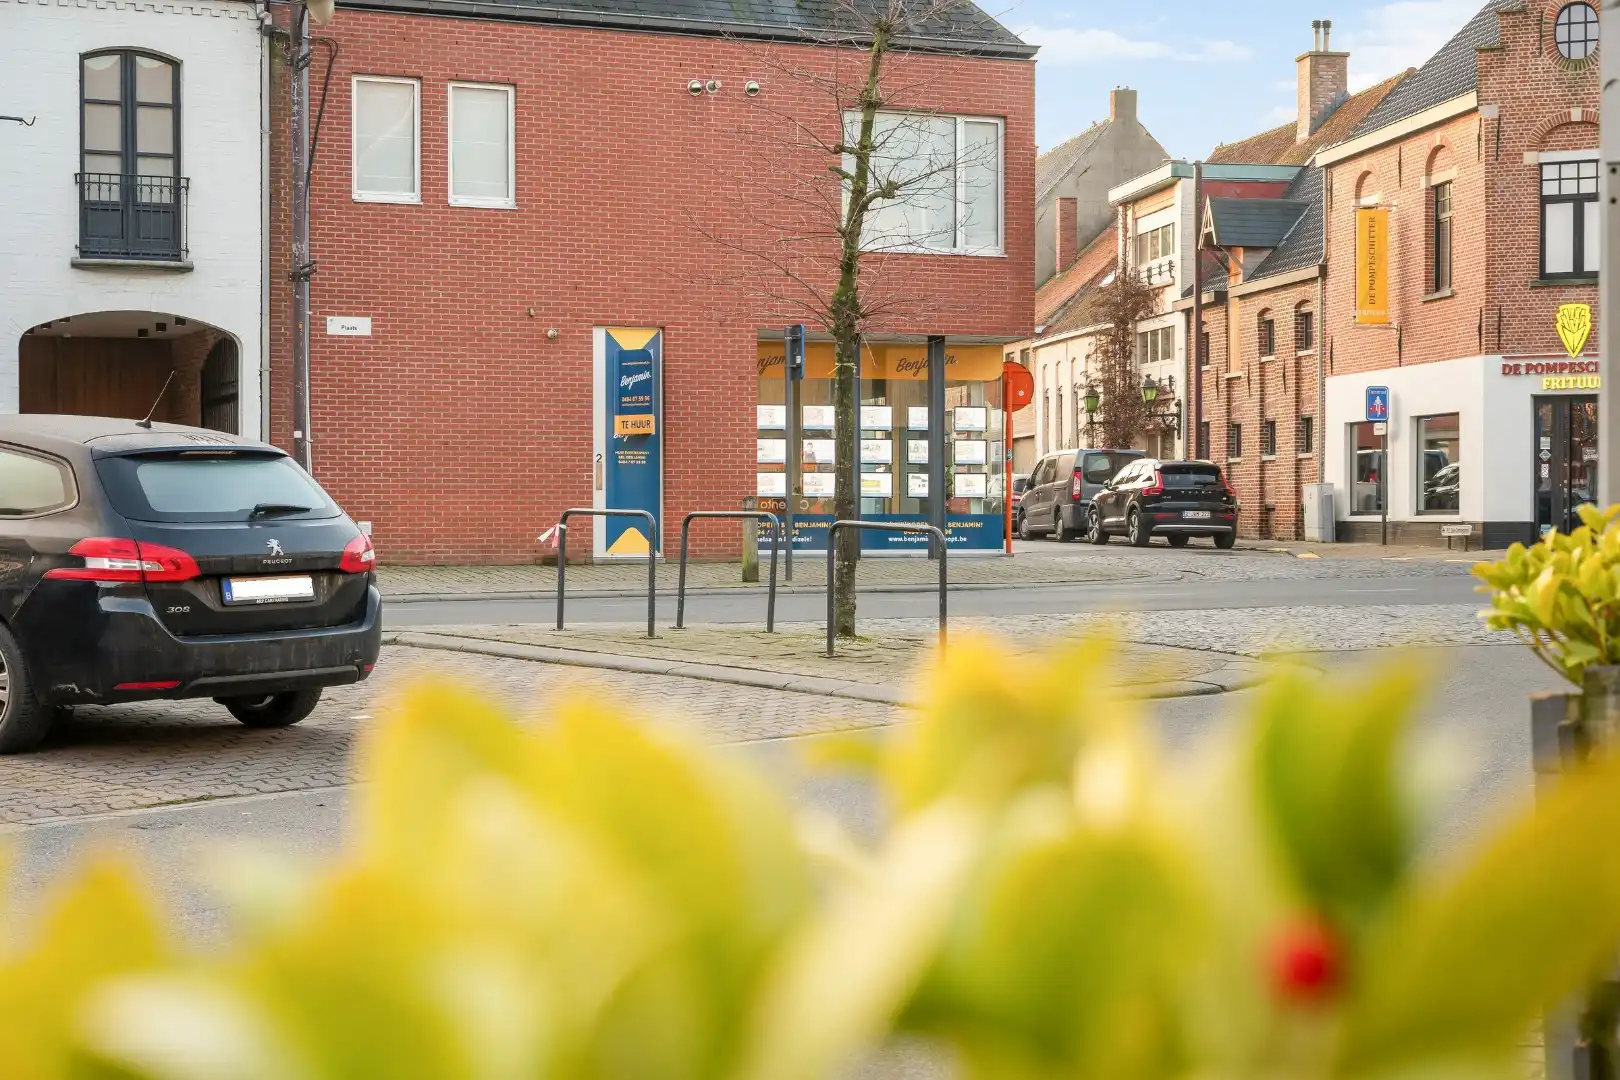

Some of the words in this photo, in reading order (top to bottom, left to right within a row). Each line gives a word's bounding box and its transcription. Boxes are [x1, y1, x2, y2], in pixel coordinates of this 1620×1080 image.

[1368, 292, 1376, 305] DE
[1502, 364, 1521, 376] DE
[622, 421, 628, 429] TE
[631, 420, 651, 428] HUUR
[596, 454, 602, 462] 2
